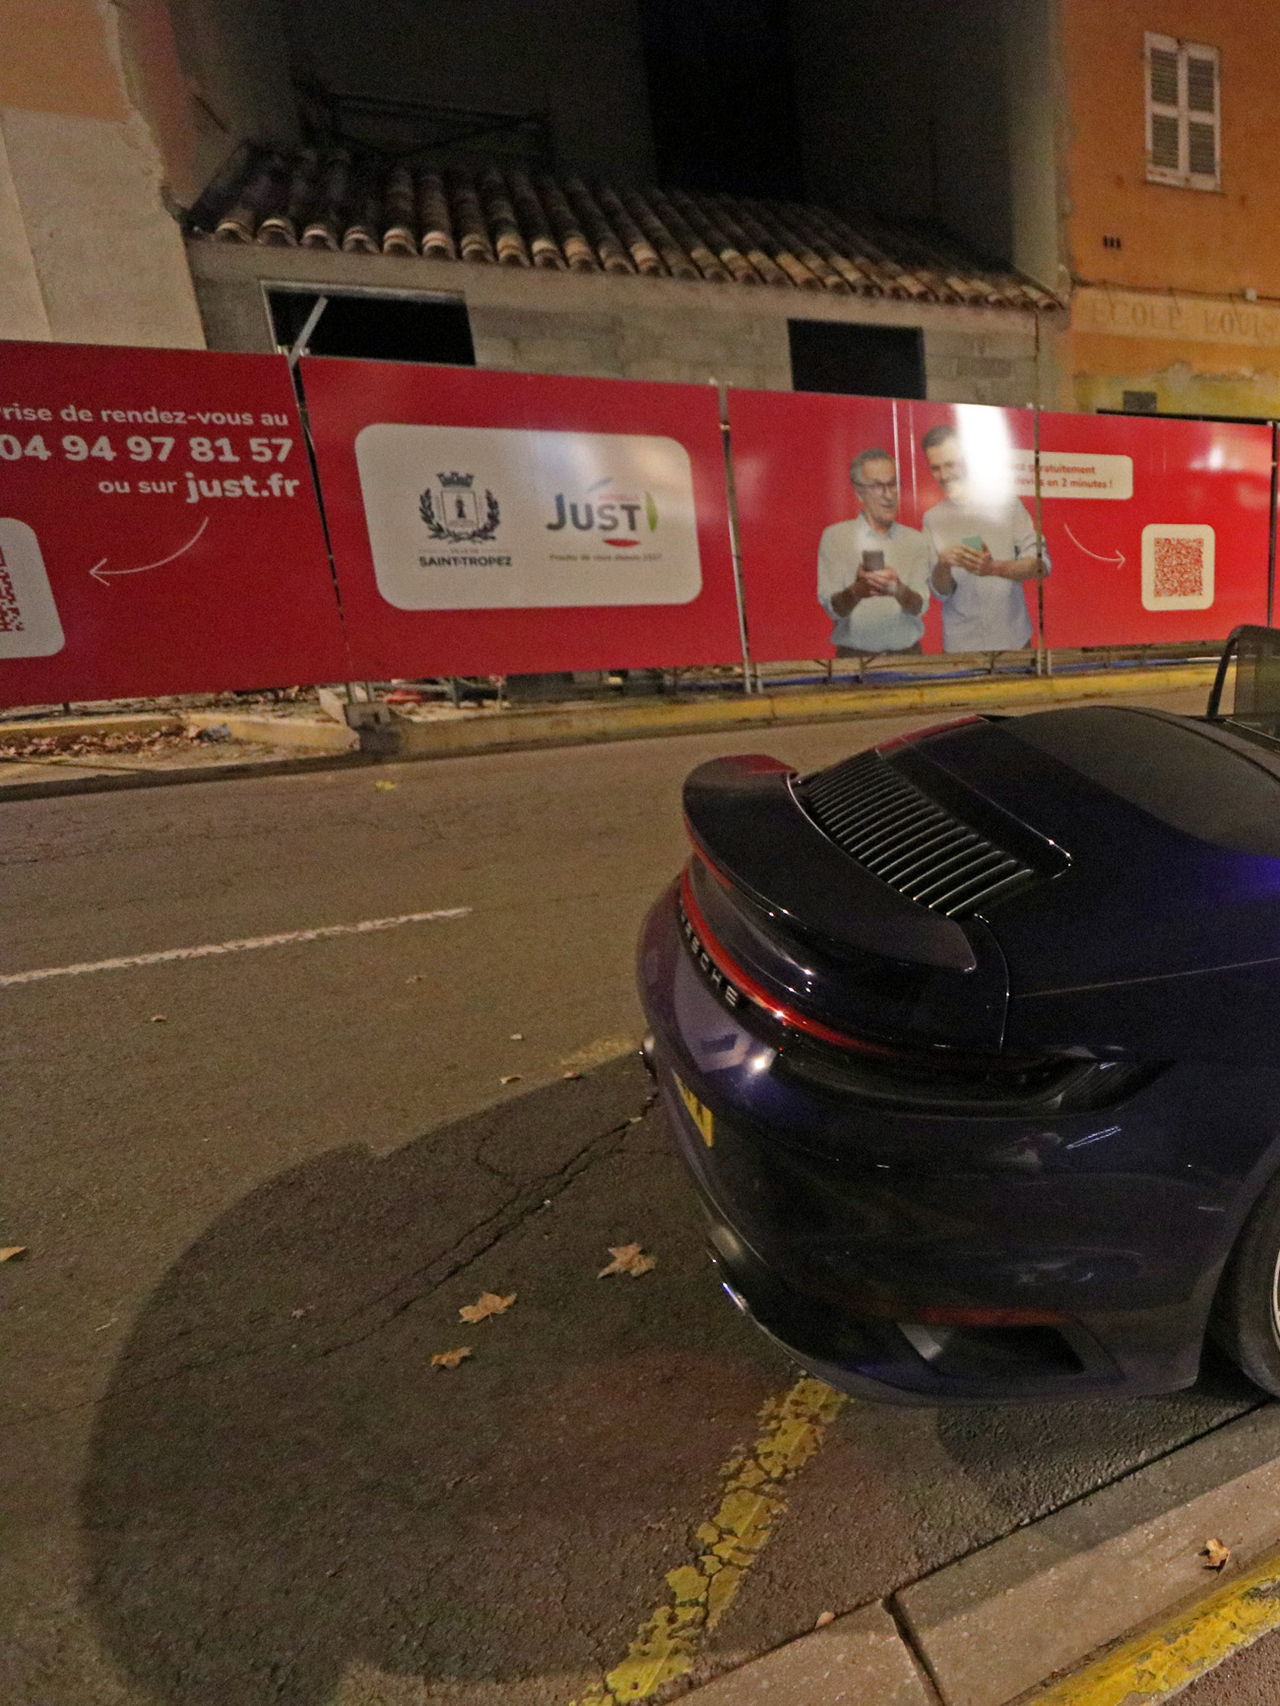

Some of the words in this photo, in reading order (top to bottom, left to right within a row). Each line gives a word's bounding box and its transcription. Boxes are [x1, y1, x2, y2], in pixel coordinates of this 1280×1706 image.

[0, 402, 53, 421] rise
[60, 404, 94, 422] de
[101, 406, 255, 426] rendez-vous
[261, 413, 289, 426] au
[0, 433, 52, 461] 04
[61, 435, 117, 461] 94
[126, 436, 175, 462] 97
[188, 436, 240, 462] 81
[249, 438, 293, 463] 57
[98, 481, 131, 494] ou
[138, 481, 178, 494] sur
[185, 471, 300, 504] just.fr
[1061, 478, 1067, 487] 2
[546, 492, 641, 531] JUST
